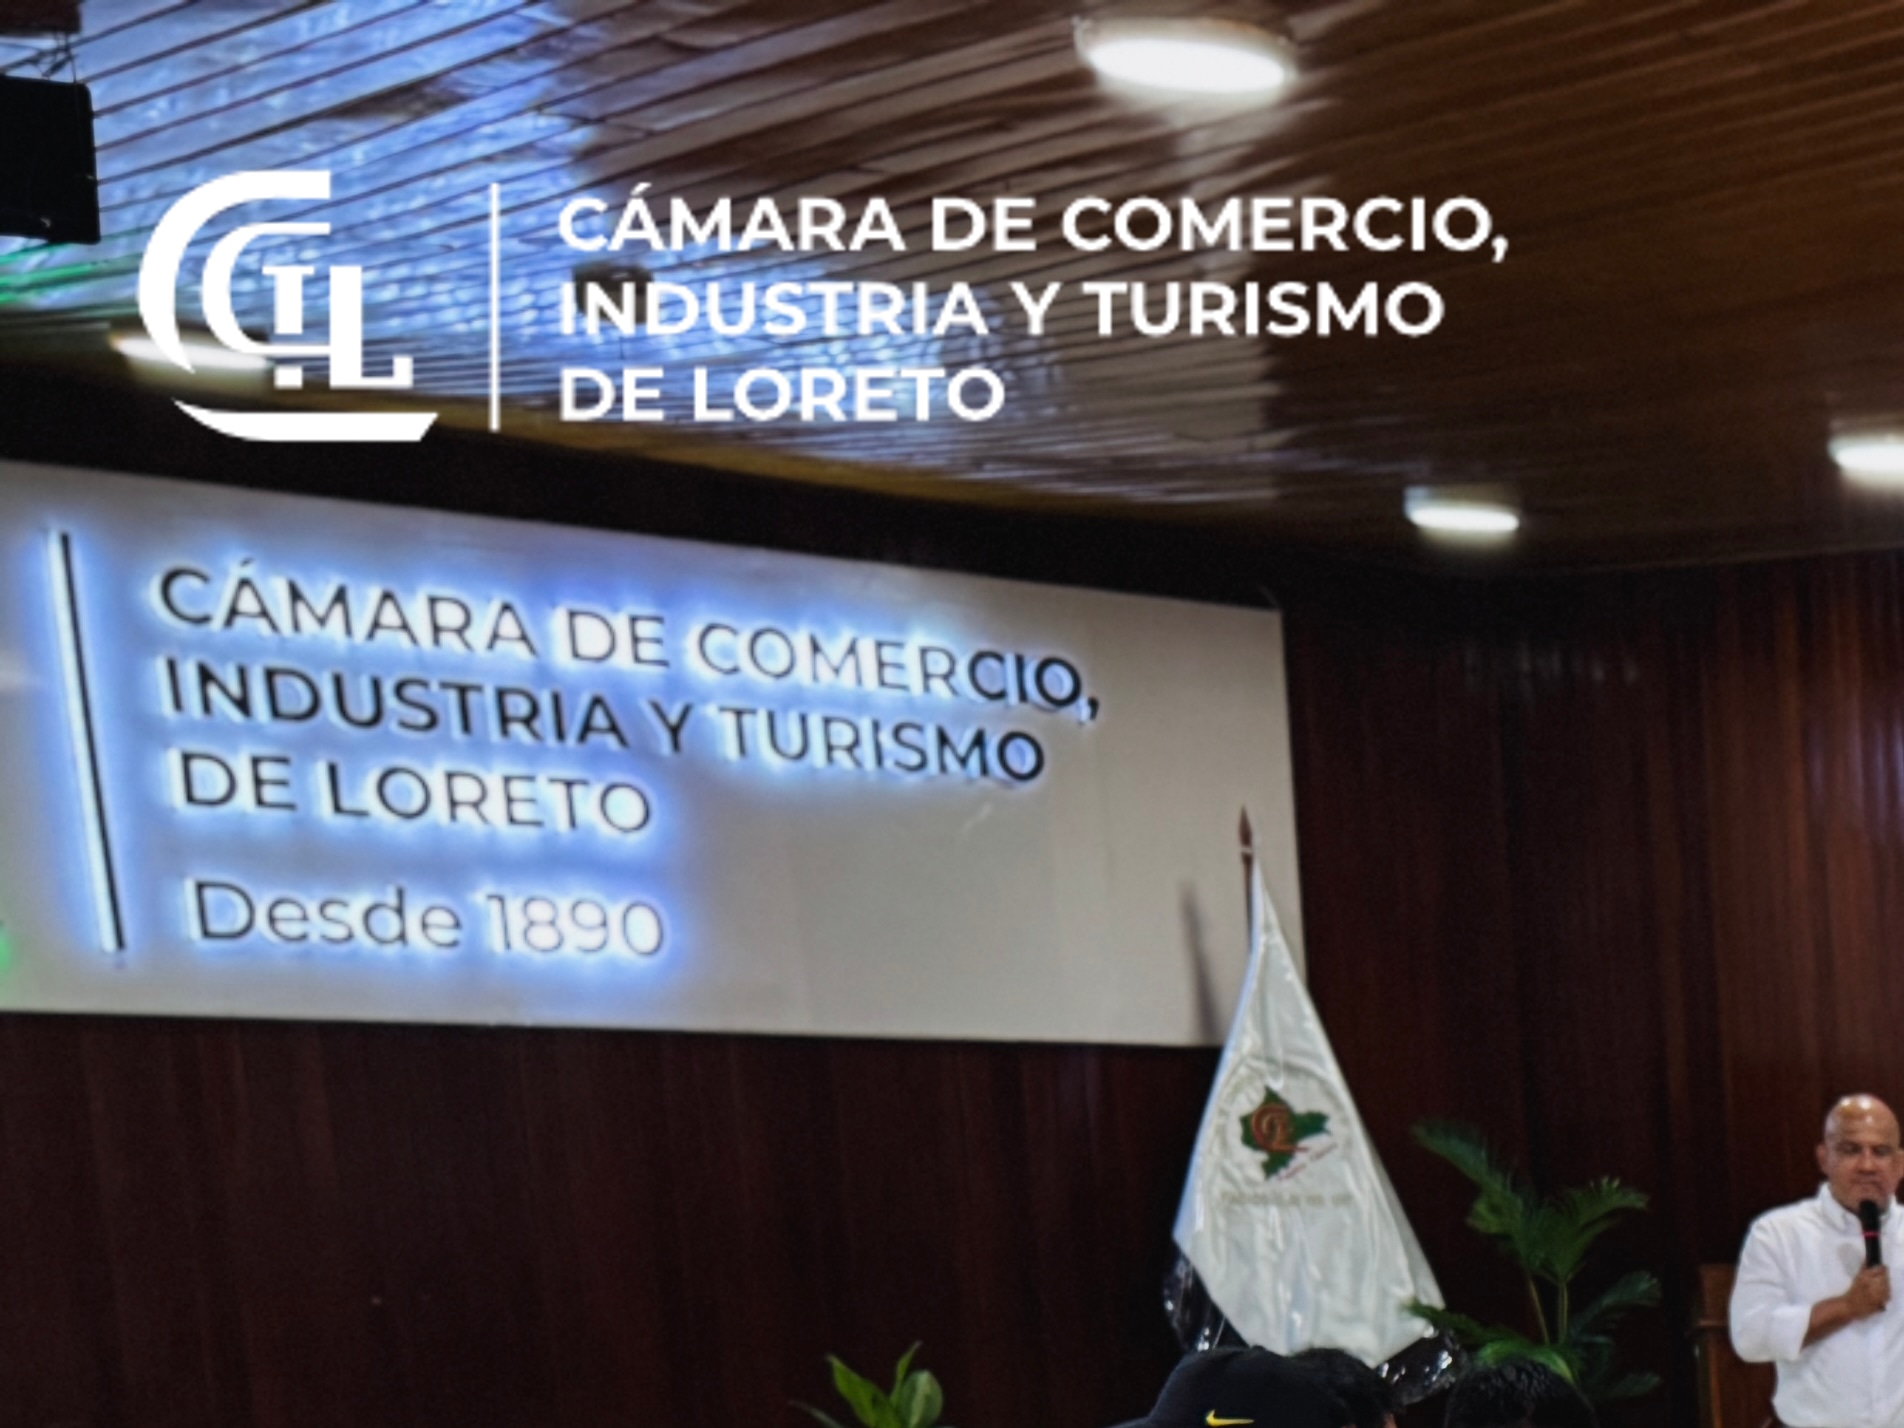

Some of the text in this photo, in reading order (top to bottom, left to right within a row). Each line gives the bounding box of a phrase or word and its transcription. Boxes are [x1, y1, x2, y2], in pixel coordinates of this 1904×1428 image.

[160, 558, 1099, 721] CÁMARA DE COMERCIO,
[166, 656, 1044, 781] INDUSTRIA Y TURISMO
[181, 752, 650, 832] DE LORETO
[195, 879, 665, 957] Desde 1890
